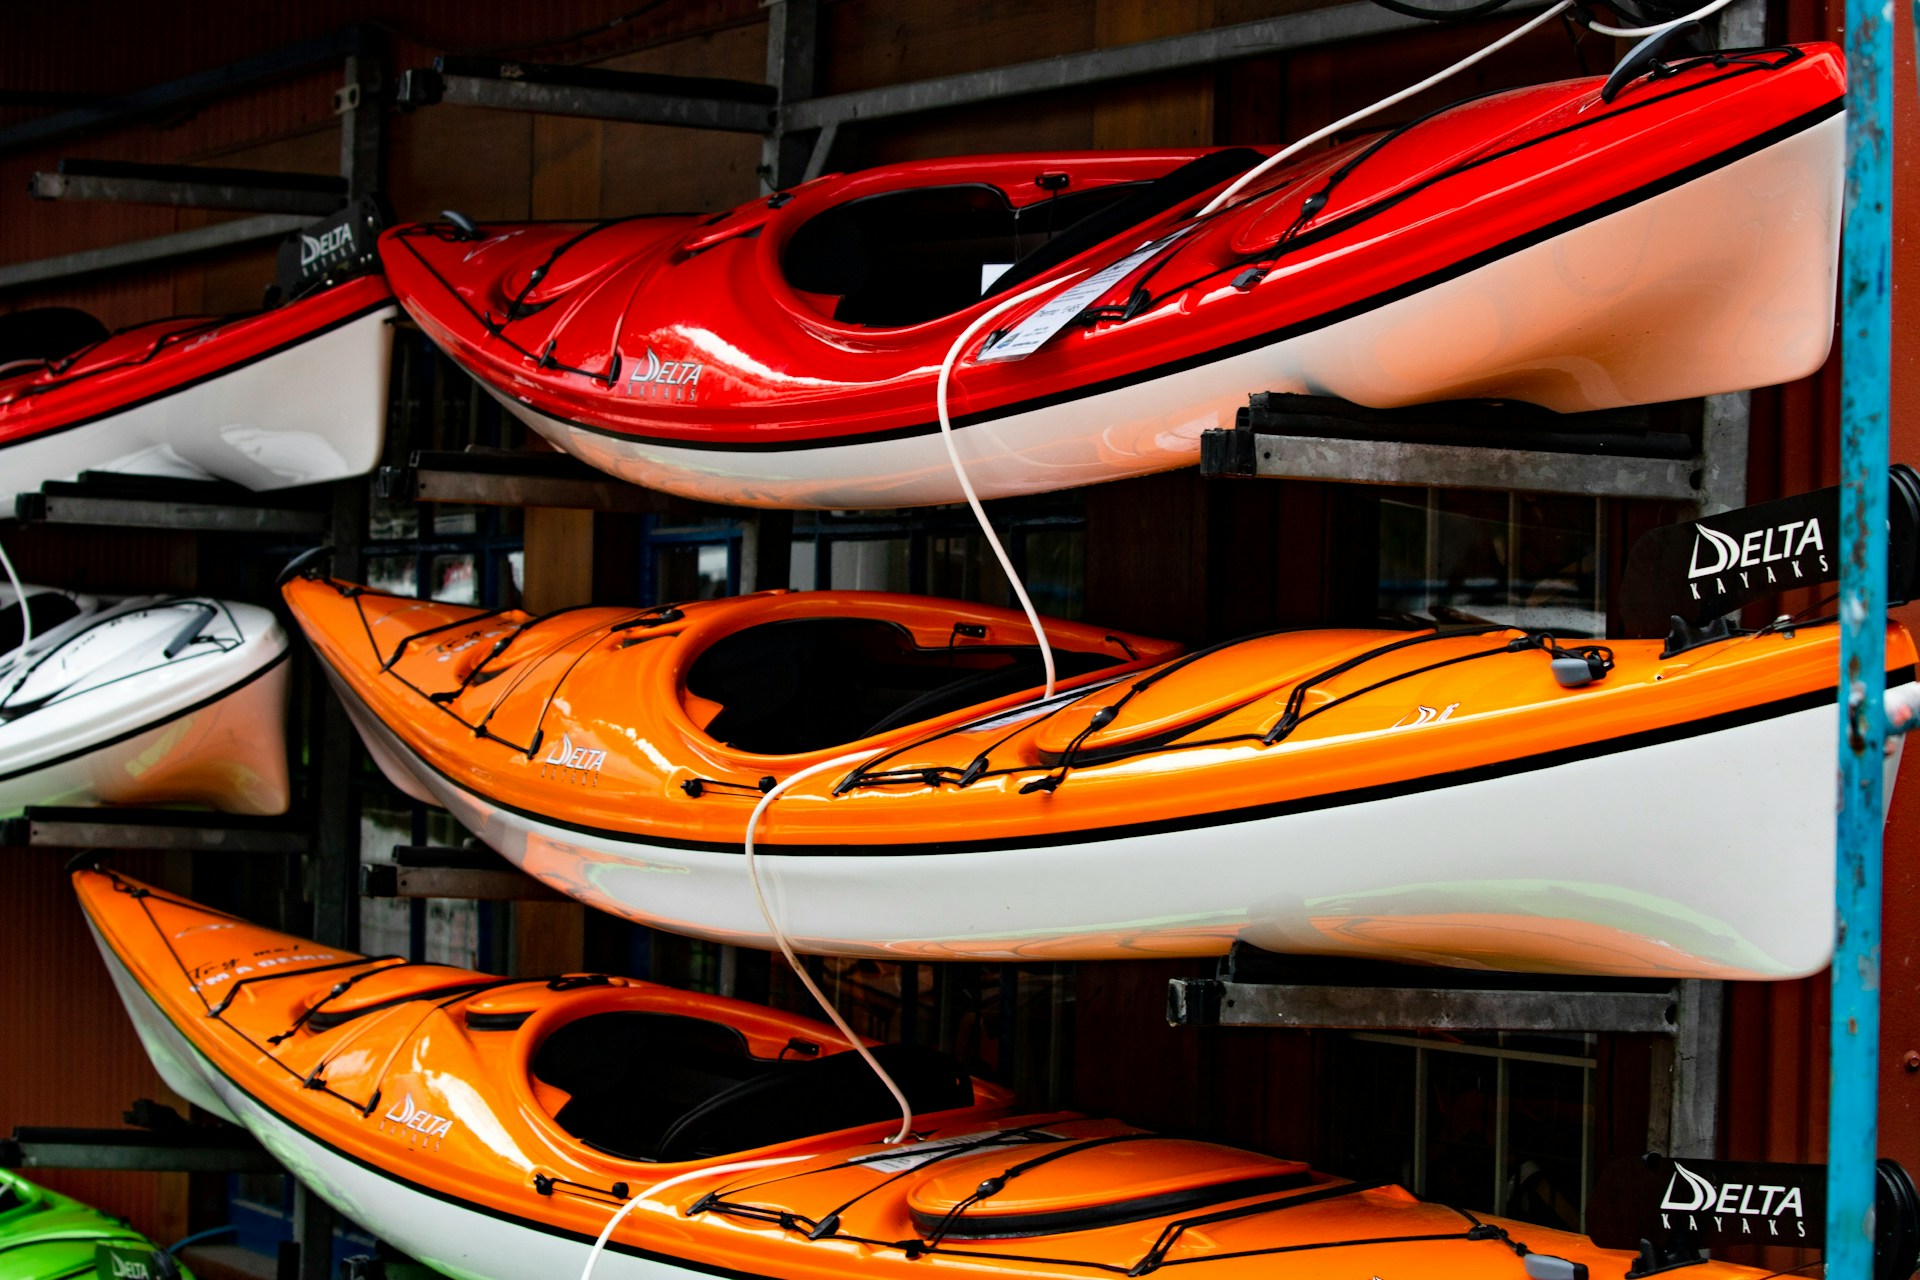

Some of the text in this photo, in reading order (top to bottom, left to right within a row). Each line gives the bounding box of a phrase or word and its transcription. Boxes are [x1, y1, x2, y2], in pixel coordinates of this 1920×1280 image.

[301, 223, 353, 266] DELTA
[629, 346, 703, 386] DELTA
[1688, 518, 1824, 579] DELTA
[1690, 555, 1828, 600] KAYAKS
[545, 732, 608, 772] DELTA
[385, 1091, 453, 1139] DELTA
[1660, 1161, 1804, 1217] DELTA
[1661, 1213, 1806, 1238] KAYAKS
[110, 1251, 150, 1280] DELTA
